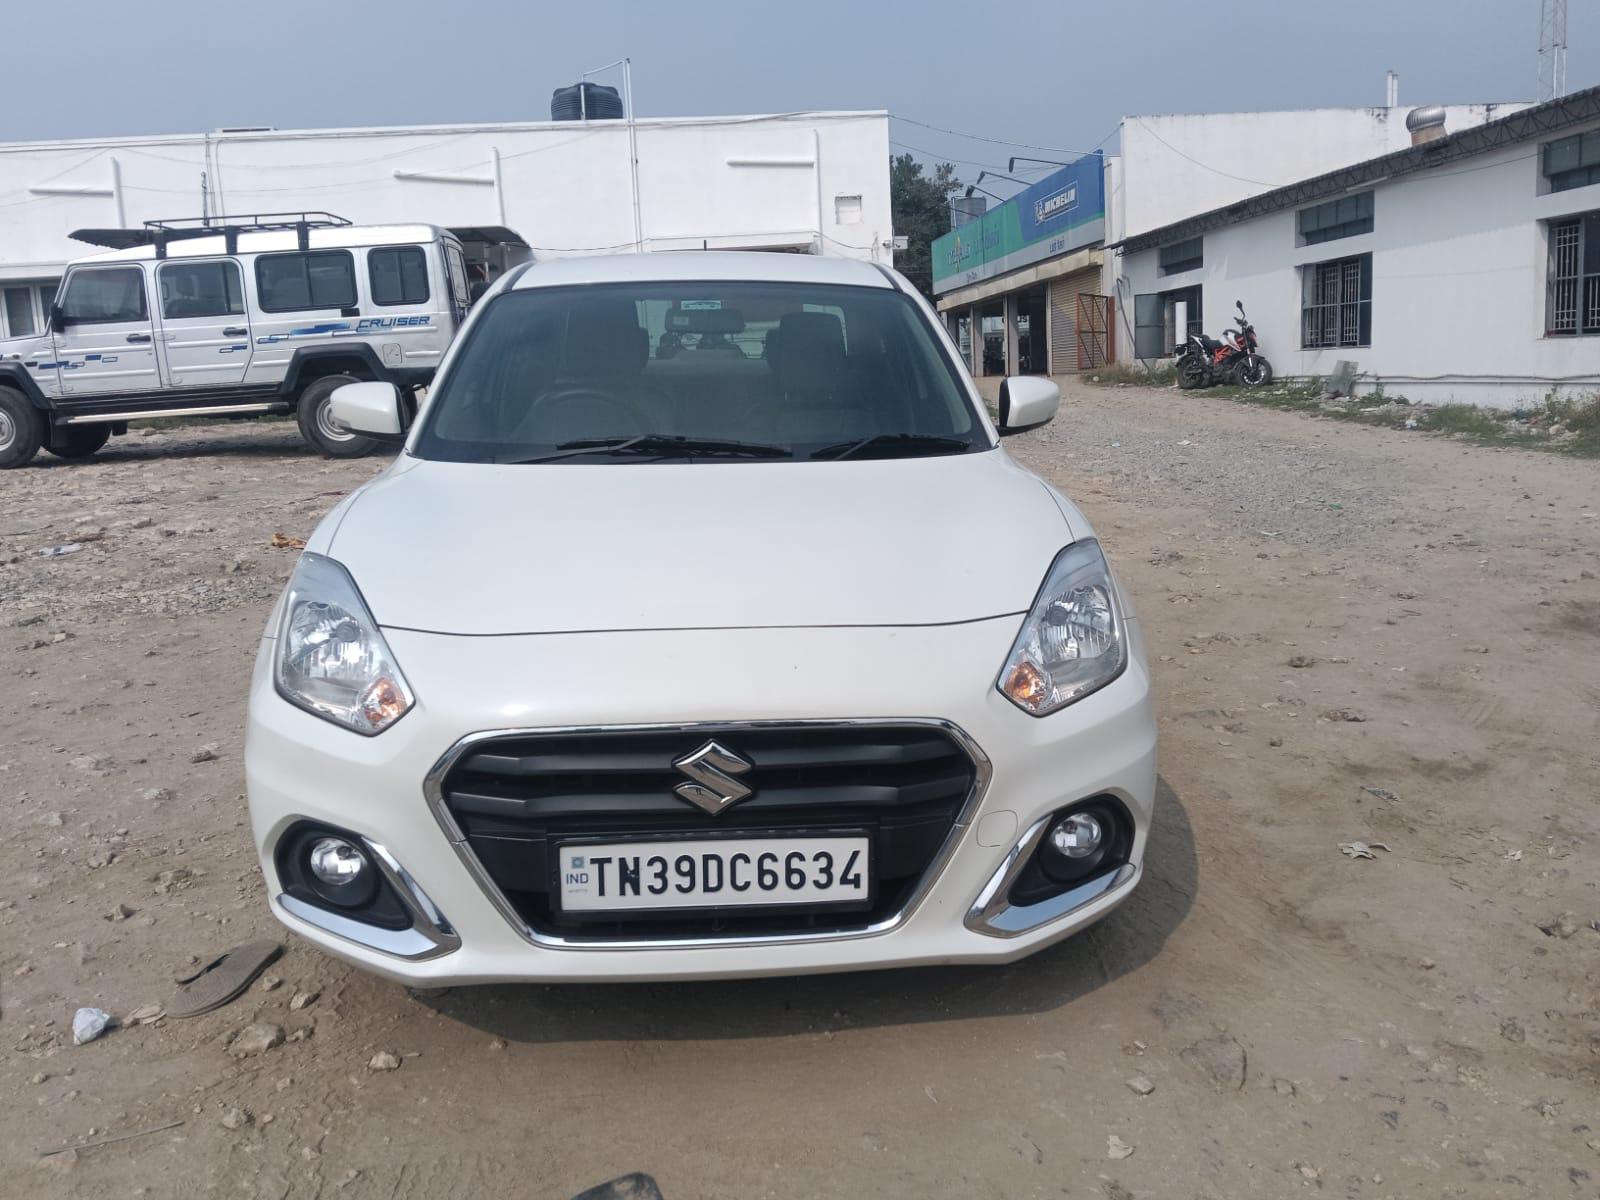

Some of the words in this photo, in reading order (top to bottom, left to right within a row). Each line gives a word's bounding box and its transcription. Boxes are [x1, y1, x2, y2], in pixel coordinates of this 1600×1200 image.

[358, 316, 430, 329] CRUISER
[565, 872, 589, 885] IND
[589, 850, 862, 897] TN39DC6634
